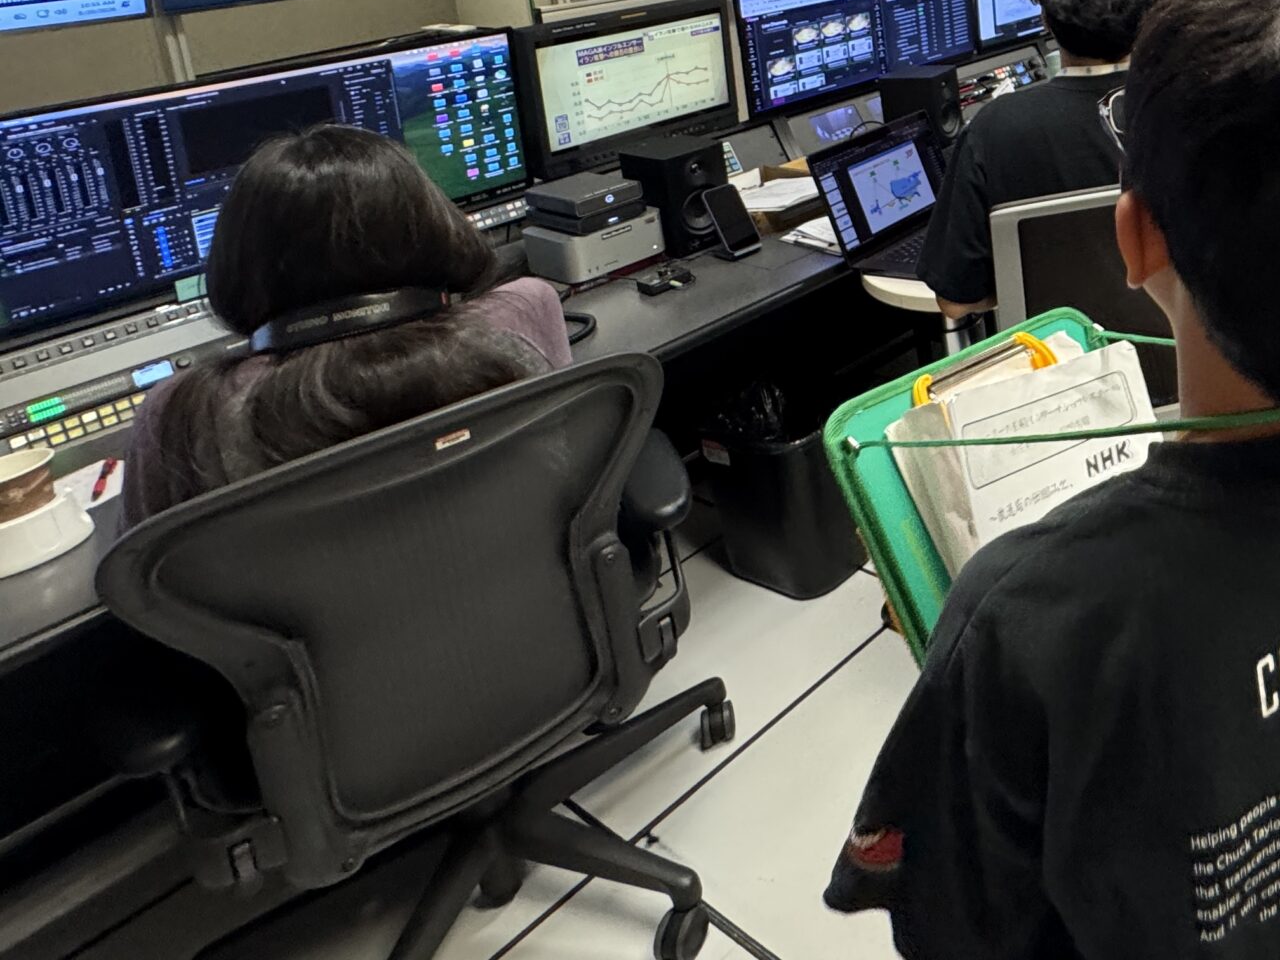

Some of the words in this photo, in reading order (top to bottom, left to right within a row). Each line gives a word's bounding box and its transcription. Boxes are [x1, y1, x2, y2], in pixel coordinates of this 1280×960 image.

[1085, 440, 1131, 478] NHK
[1191, 823, 1238, 851] Helping
[1240, 794, 1277, 832] people
[1193, 862, 1214, 876] the
[1216, 838, 1252, 871] Chuck
[1195, 882, 1220, 900] that
[1197, 892, 1241, 920] enables
[1259, 904, 1278, 922] the
[1200, 923, 1225, 942] And
